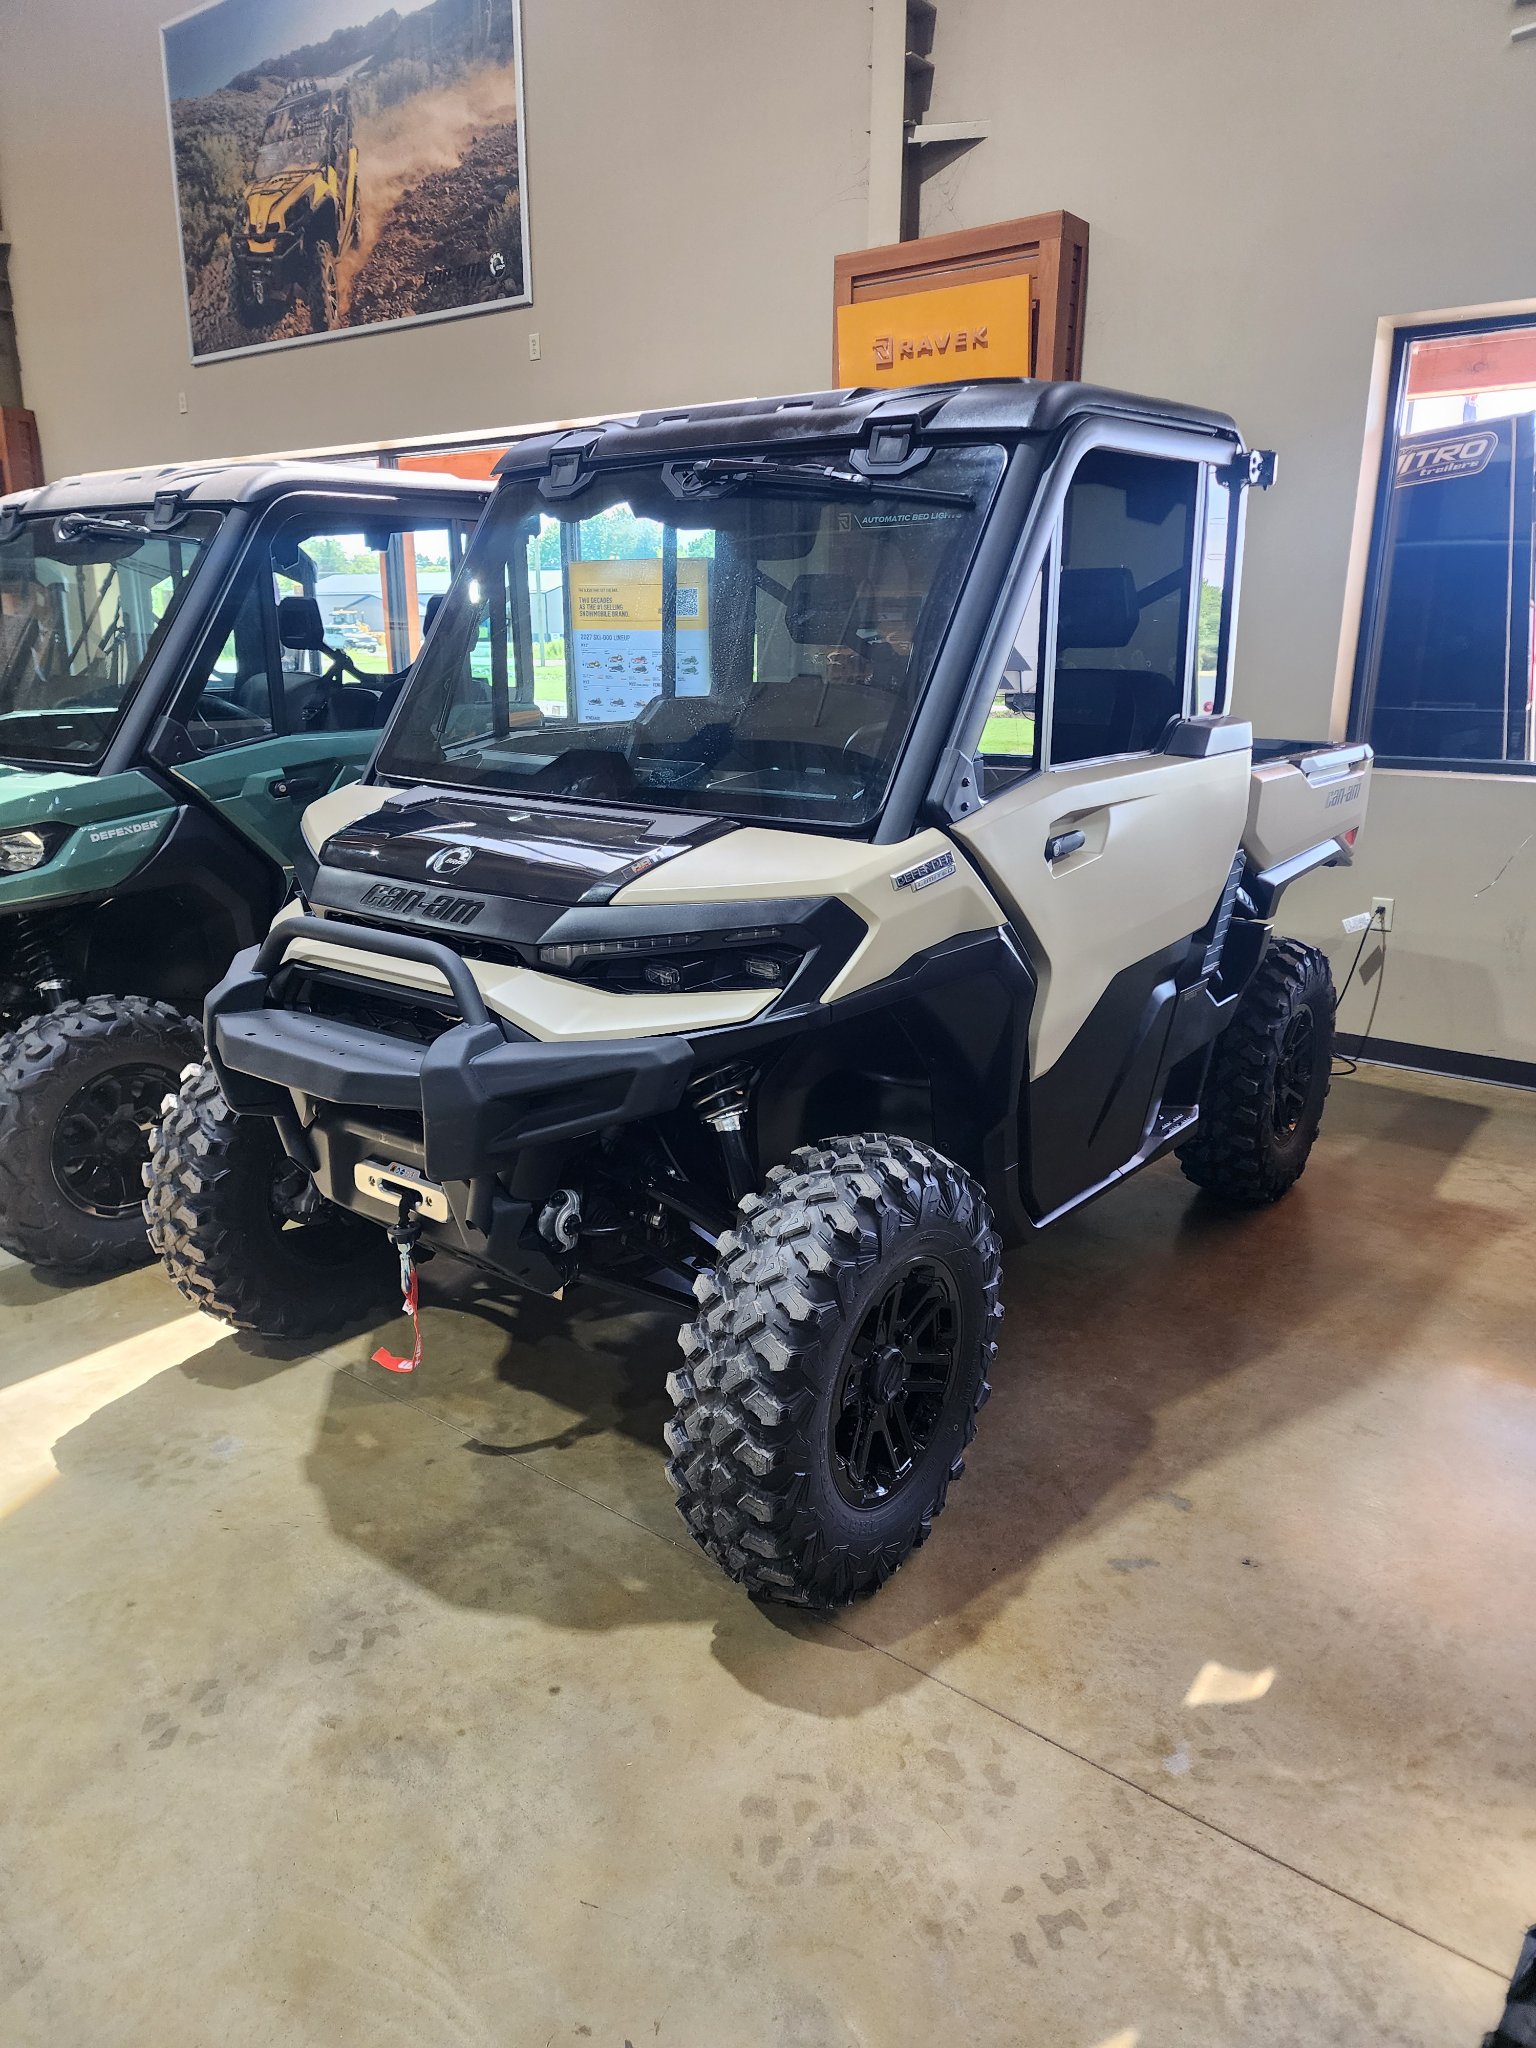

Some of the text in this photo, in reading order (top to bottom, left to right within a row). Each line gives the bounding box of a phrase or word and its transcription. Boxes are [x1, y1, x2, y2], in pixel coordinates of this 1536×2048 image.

[900, 326, 989, 360] RAVEK
[1419, 461, 1480, 477] trailers
[862, 514, 911, 524] AUTOMATIC
[912, 513, 930, 521] BED
[89, 820, 159, 843] DEFENDER
[896, 853, 954, 887] DEFENDER
